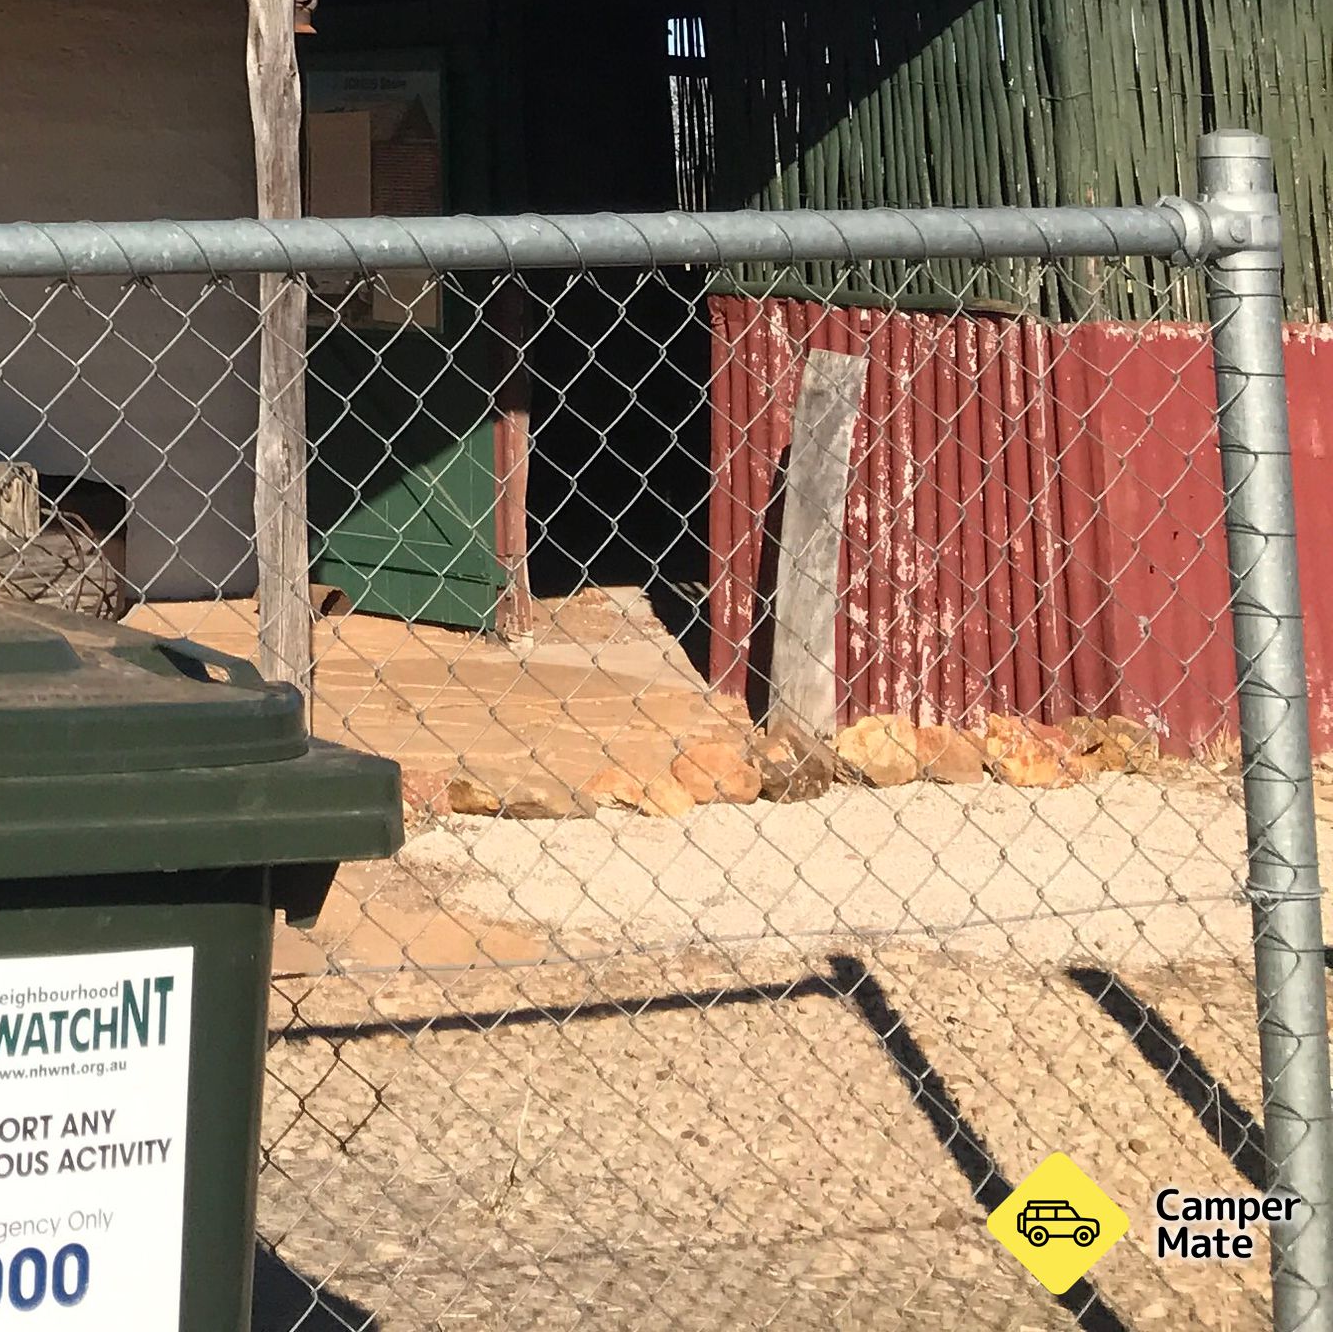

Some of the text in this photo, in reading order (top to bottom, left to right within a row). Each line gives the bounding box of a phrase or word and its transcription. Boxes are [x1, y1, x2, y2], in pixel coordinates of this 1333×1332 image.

[60, 1109, 117, 1138] ANY
[57, 1138, 173, 1174] ACTIVITY
[68, 1208, 114, 1233] Only
